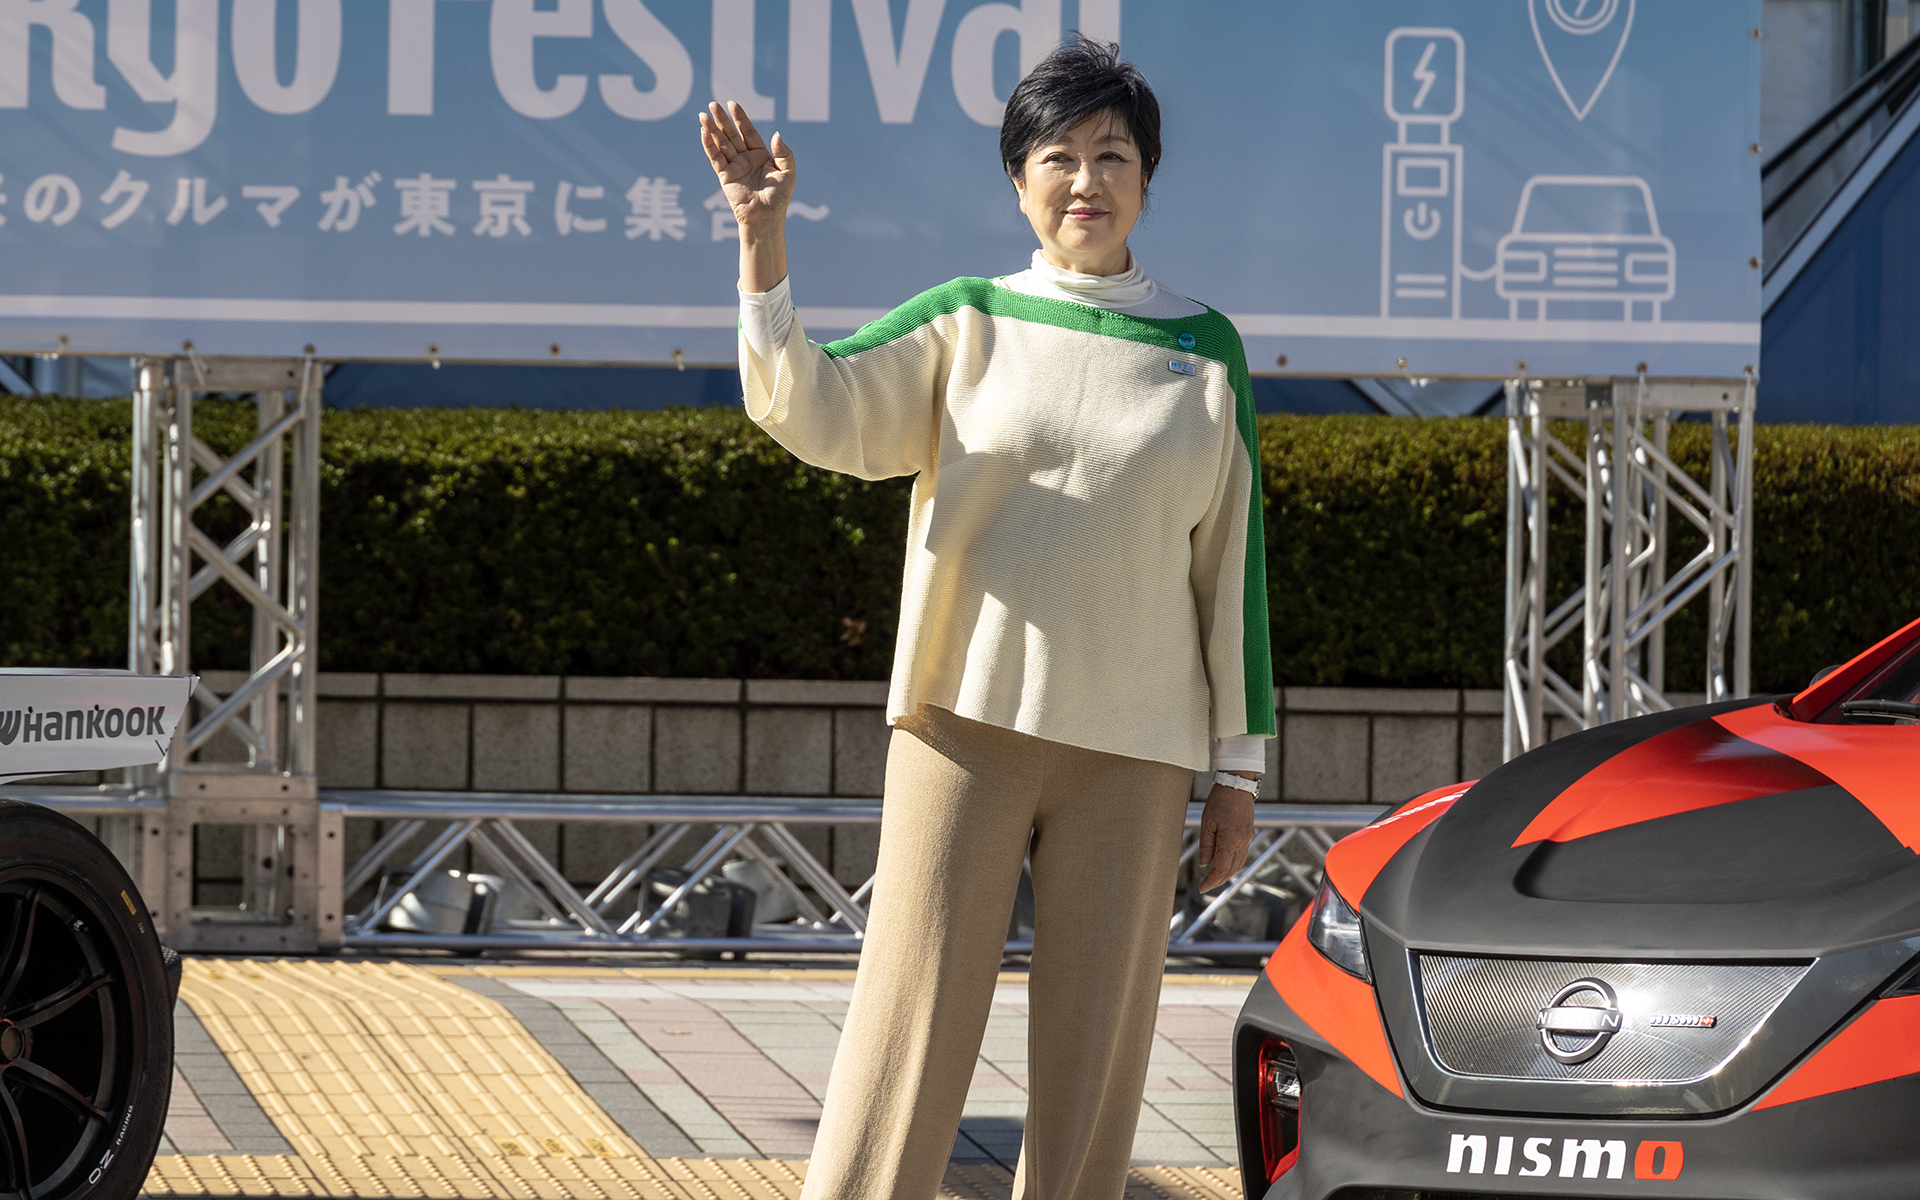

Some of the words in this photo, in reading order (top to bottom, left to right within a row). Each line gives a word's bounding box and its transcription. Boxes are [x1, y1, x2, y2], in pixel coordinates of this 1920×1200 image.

[387, 0, 1121, 127] estiva
[115, 1105, 134, 1146] RACING
[1446, 1133, 1684, 1181] nismo
